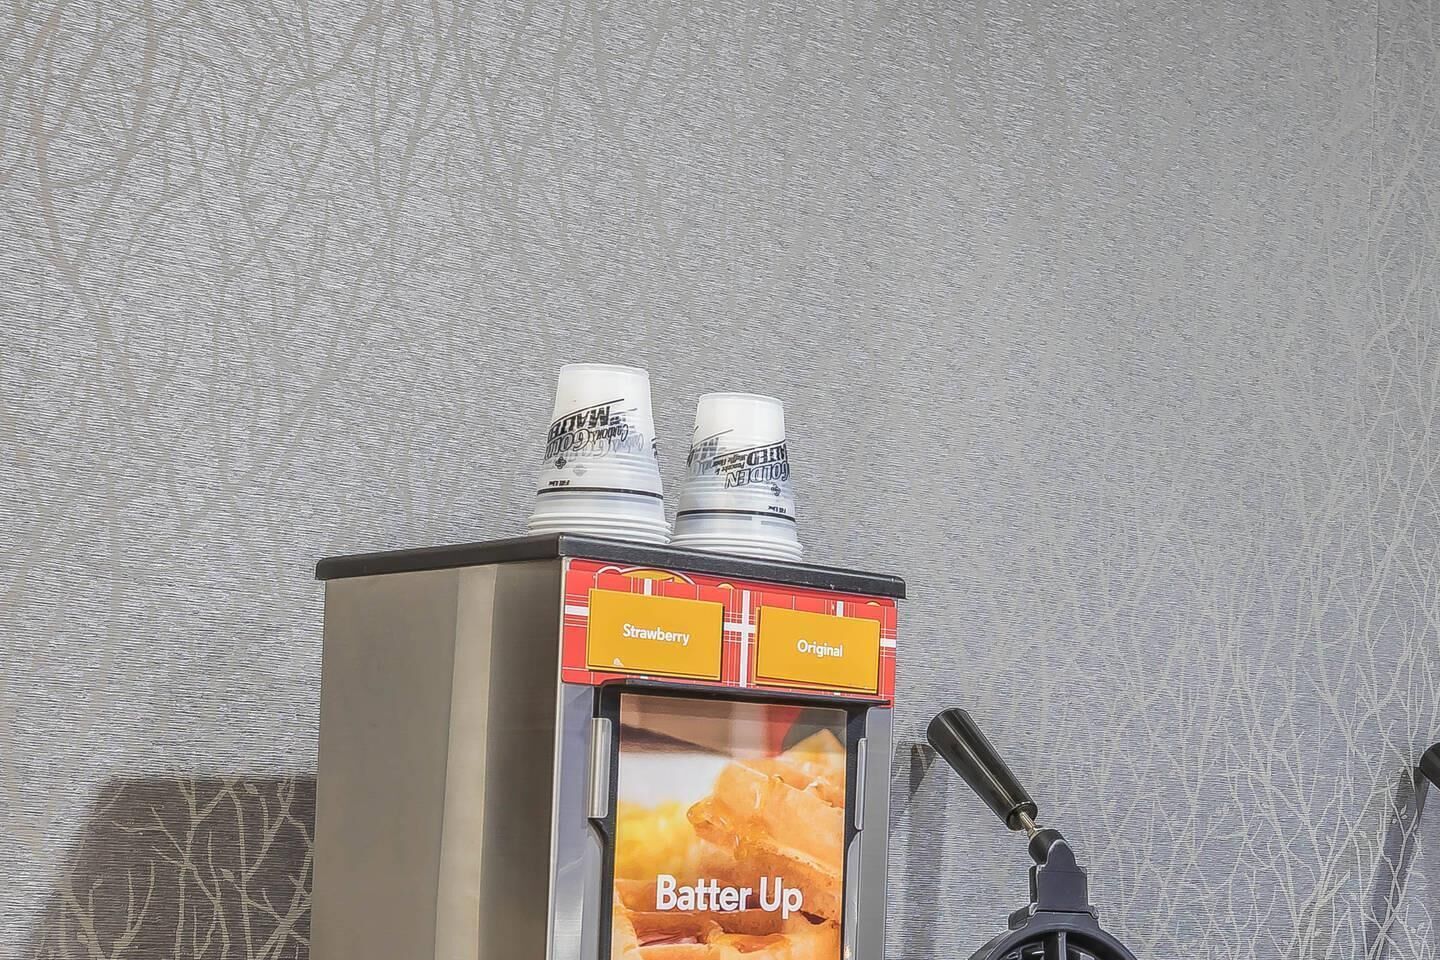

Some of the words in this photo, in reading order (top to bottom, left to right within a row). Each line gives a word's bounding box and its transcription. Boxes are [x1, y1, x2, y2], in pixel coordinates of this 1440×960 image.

[622, 623, 690, 646] Strawberry
[797, 639, 843, 658] Original
[656, 874, 752, 912] Batter
[759, 876, 803, 920] Up
